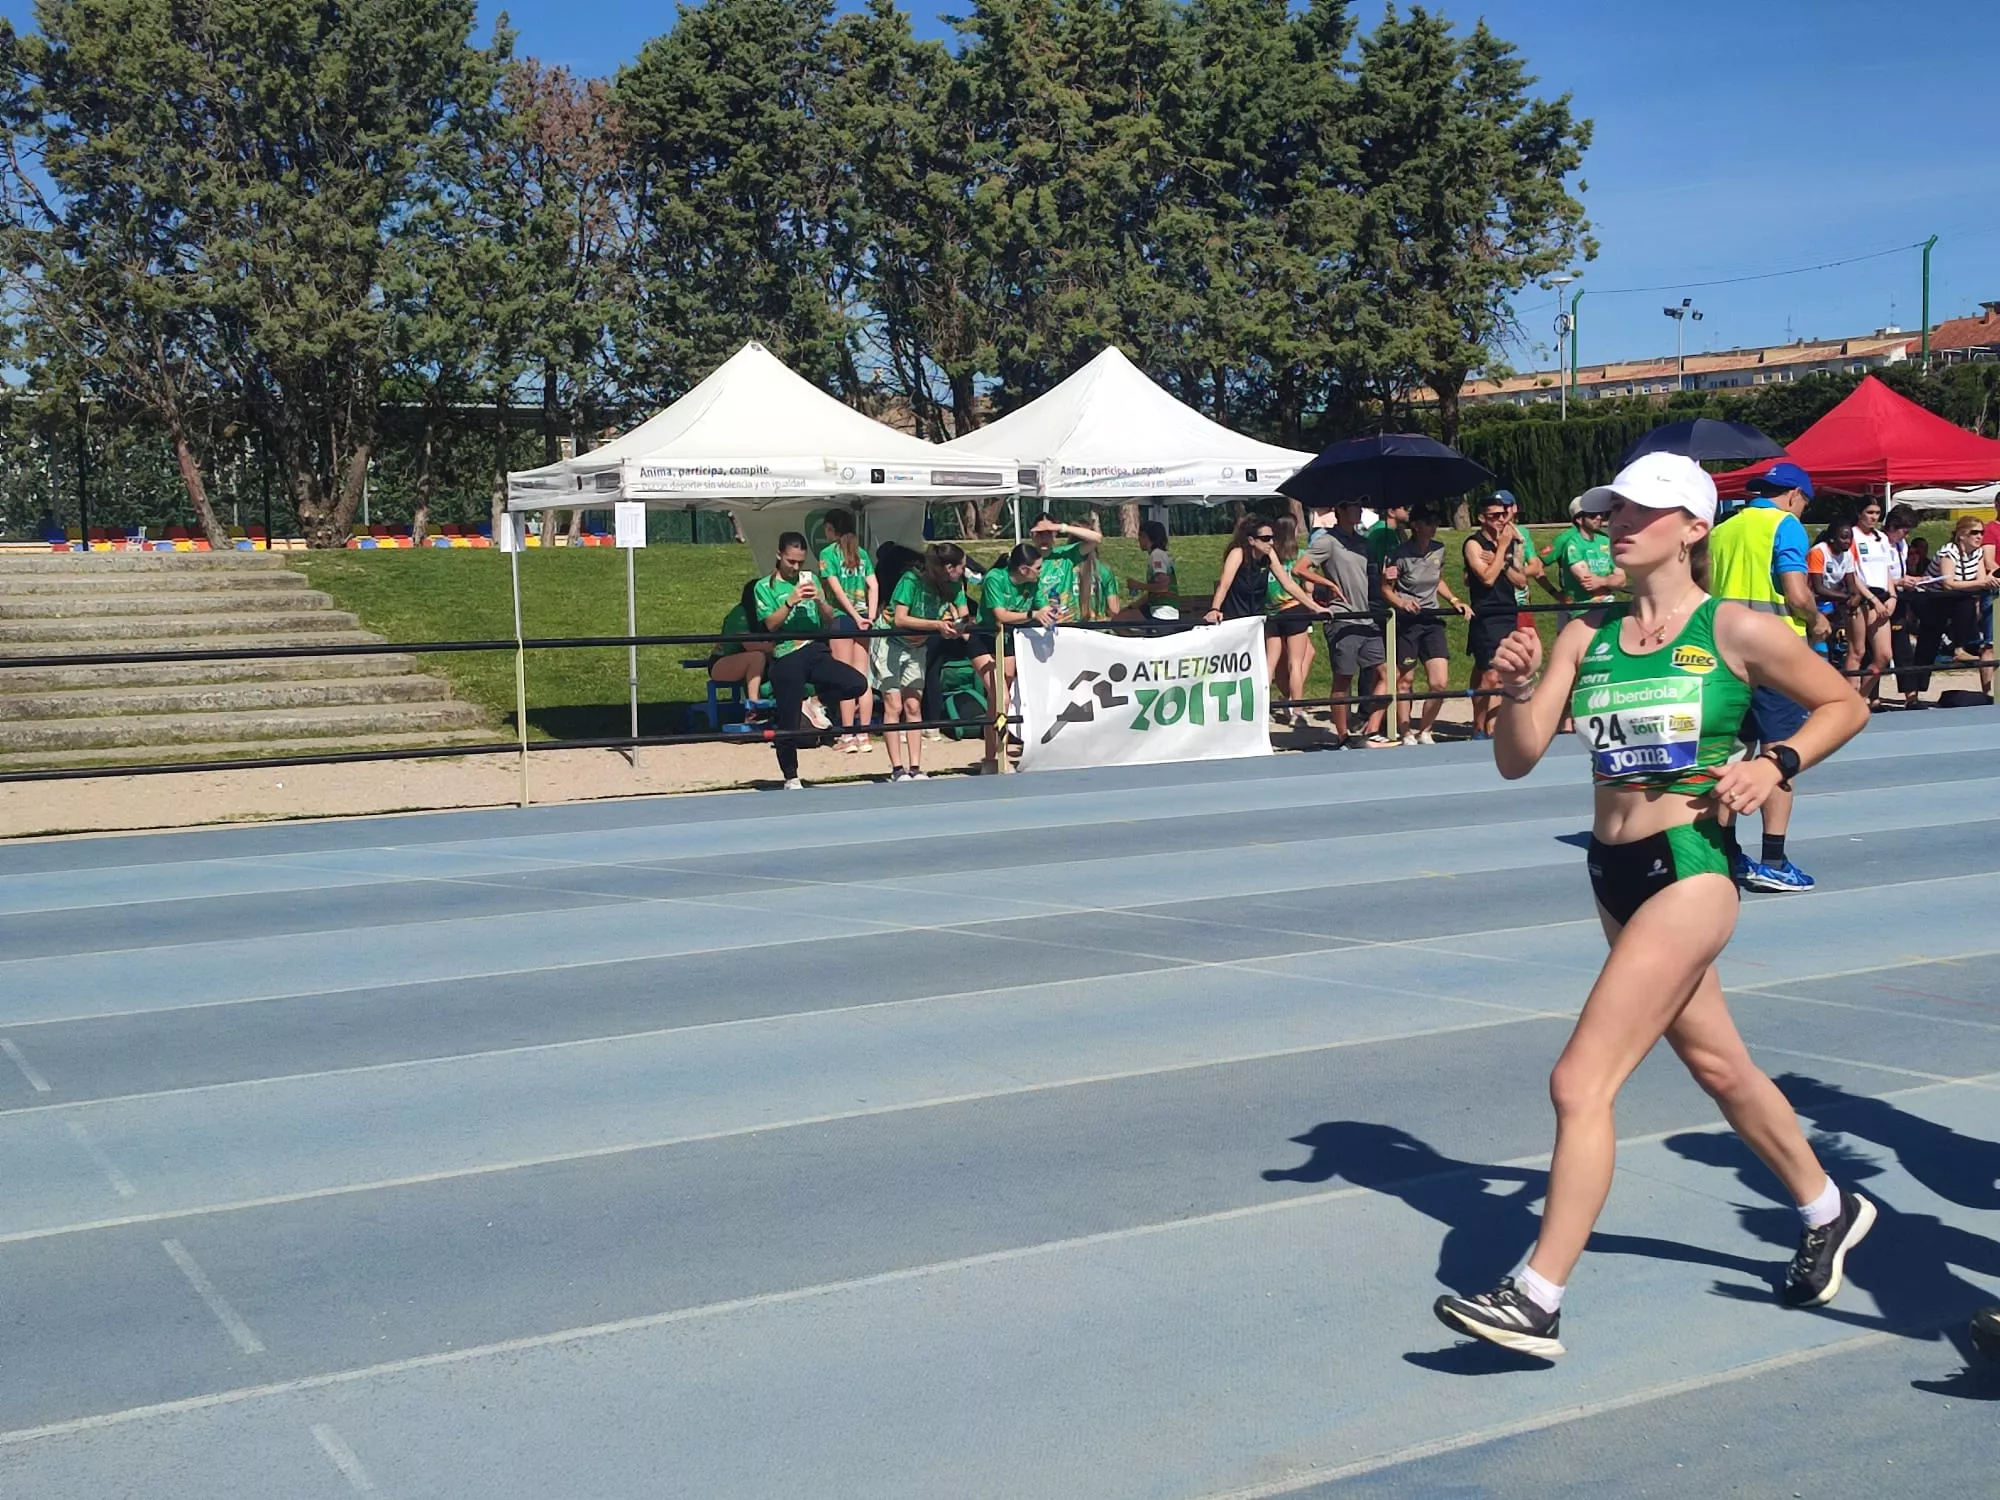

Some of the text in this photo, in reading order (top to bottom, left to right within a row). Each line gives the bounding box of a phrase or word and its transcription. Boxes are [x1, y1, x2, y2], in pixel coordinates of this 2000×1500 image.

[640, 465, 773, 479] Anima, participa, compite.
[1060, 466, 1089, 476] Anima,
[1091, 466, 1131, 477] participa,
[1132, 652, 1251, 682] ATLETISMO
[1674, 649, 1716, 667] intec
[1129, 677, 1254, 730] ZOITI
[1613, 686, 1678, 705] Iberdrola
[1590, 714, 1627, 749] 24
